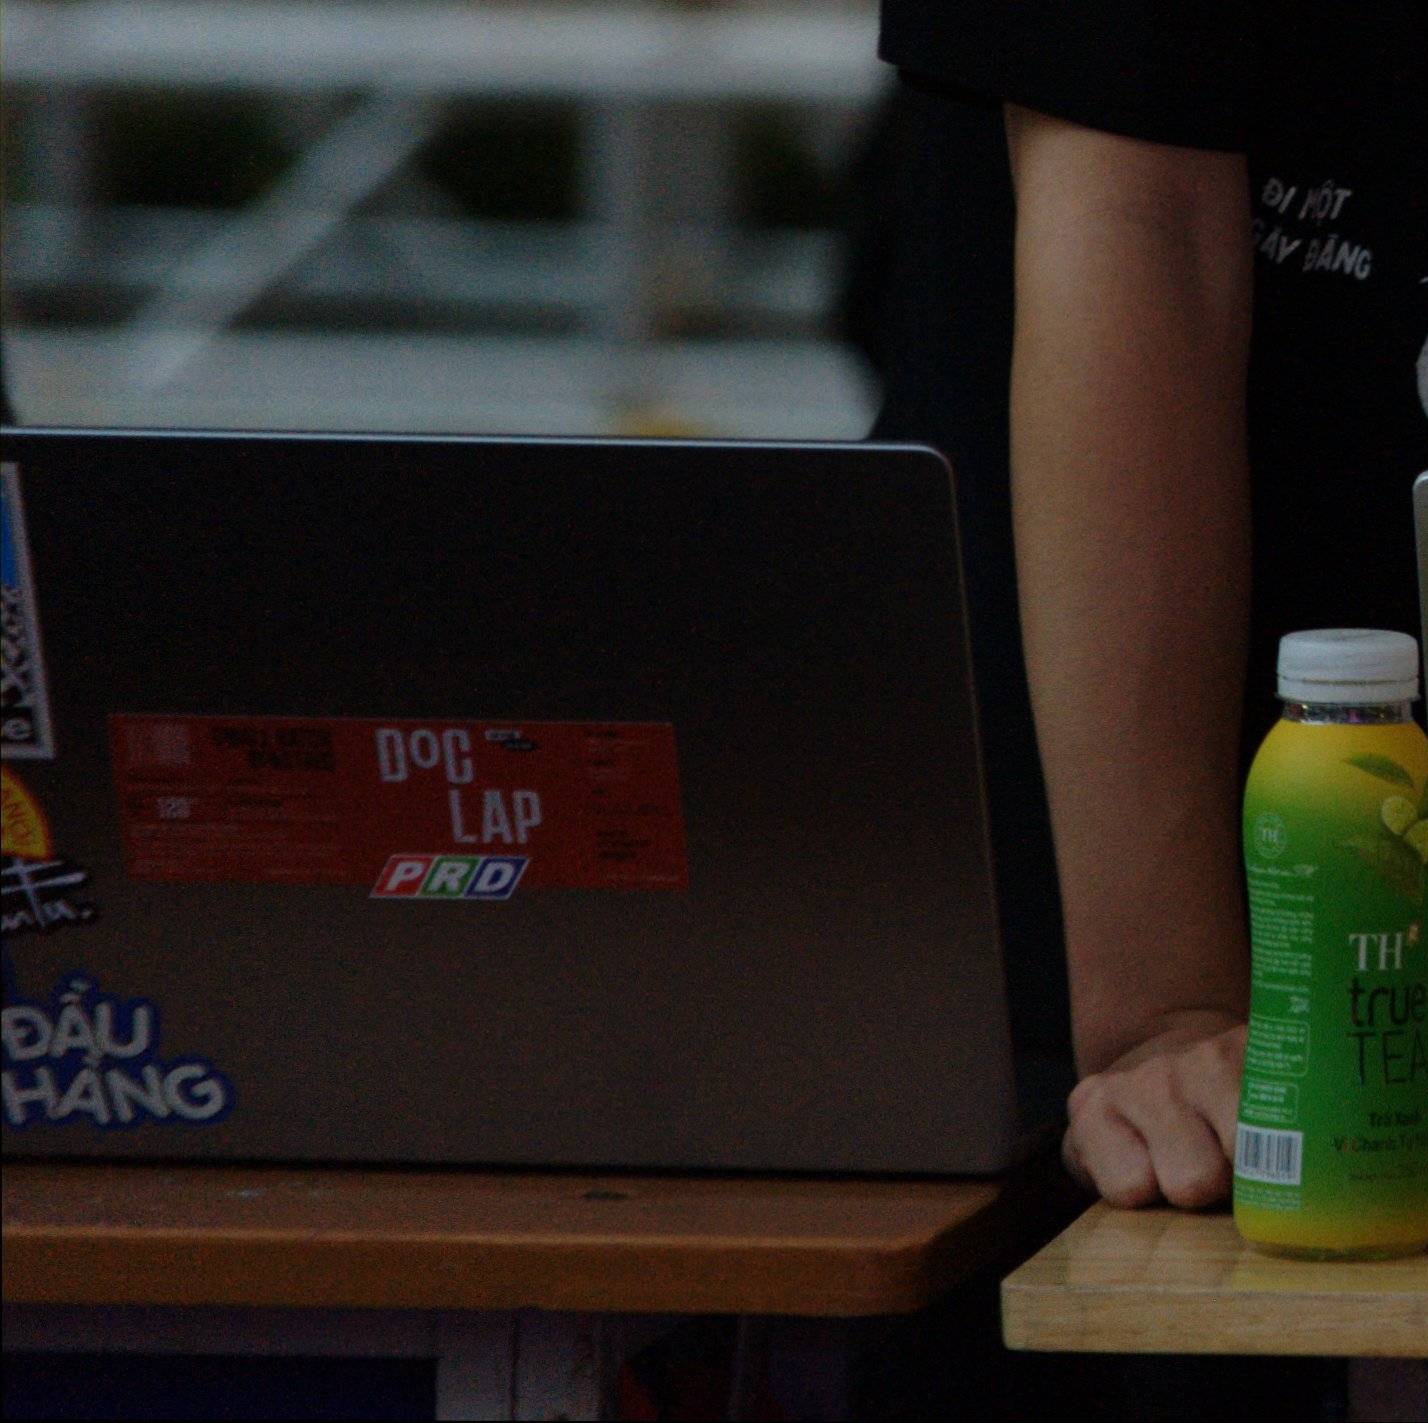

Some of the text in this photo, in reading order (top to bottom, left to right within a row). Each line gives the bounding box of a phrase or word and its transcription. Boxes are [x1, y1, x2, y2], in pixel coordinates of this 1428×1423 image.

[448, 788, 544, 846] LAP
[384, 859, 520, 894] PRD
[1347, 931, 1405, 972] TH
[0, 978, 153, 1062] ĐẦU
[1347, 977, 1427, 1028] true
[0, 1052, 227, 1126] HÀNG
